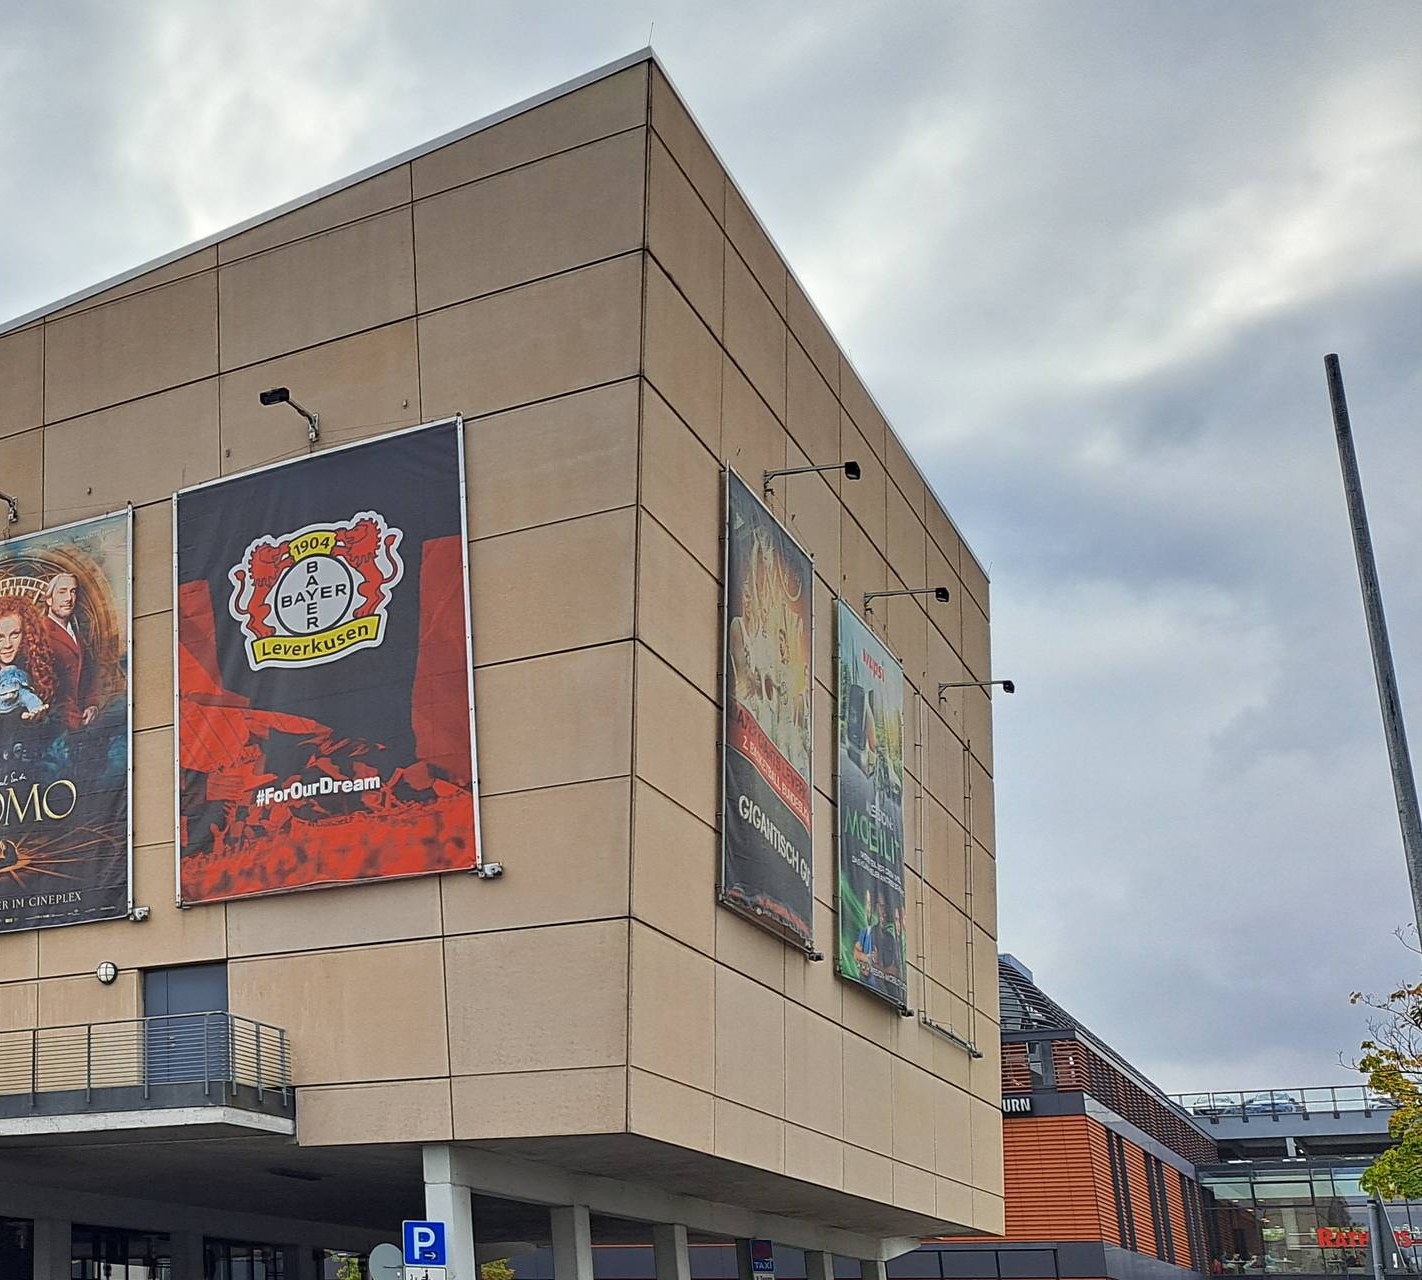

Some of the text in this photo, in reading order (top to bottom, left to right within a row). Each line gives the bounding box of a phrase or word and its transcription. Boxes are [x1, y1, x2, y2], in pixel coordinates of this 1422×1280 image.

[292, 536, 331, 555] 1904
[281, 583, 347, 608] BAYER
[306, 561, 319, 630] BAYER
[261, 623, 369, 657] Leverkusen
[256, 776, 381, 806] #ForOurDream
[738, 795, 799, 873] GIGANTISCH
[12, 898, 25, 909] IM
[28, 891, 82, 907] CINEPLEX
[1002, 1098, 1032, 1113] URN
[413, 1227, 436, 1260] P
[754, 1261, 773, 1270] TAXI
